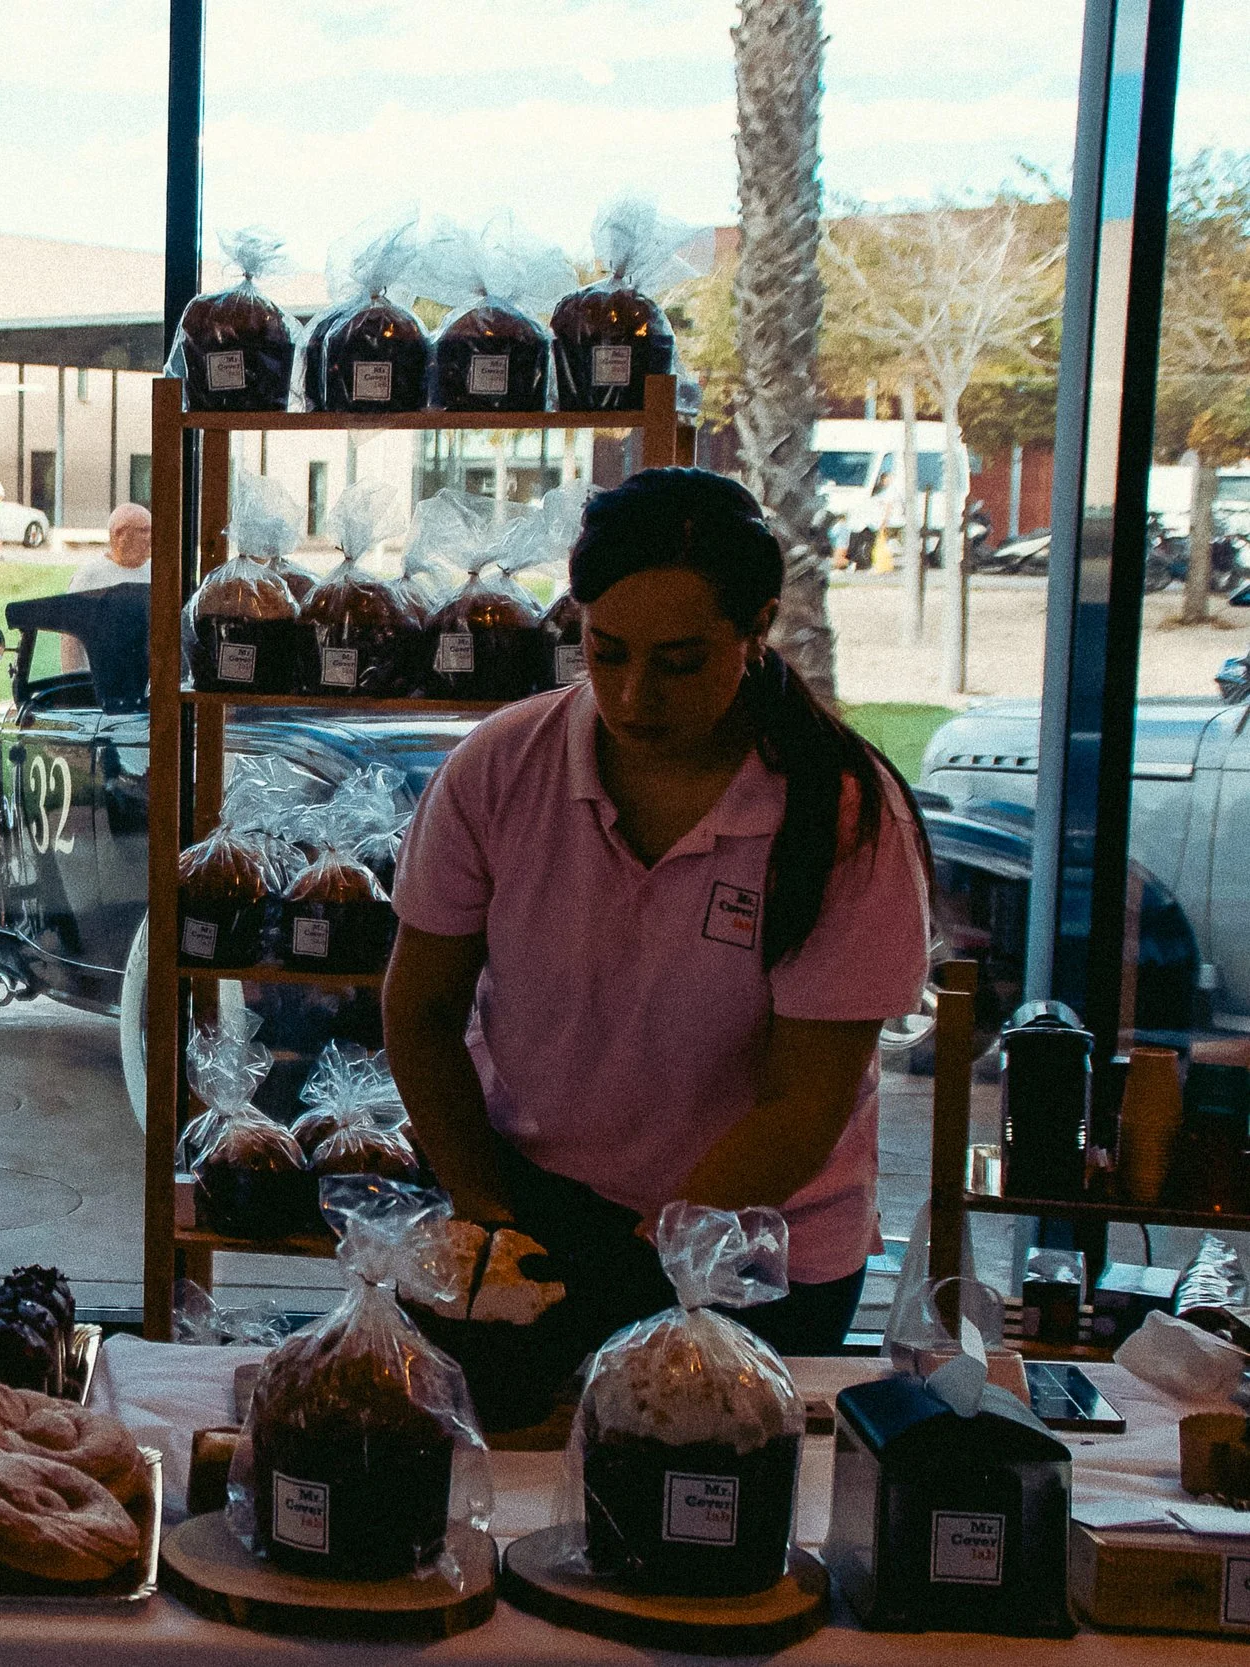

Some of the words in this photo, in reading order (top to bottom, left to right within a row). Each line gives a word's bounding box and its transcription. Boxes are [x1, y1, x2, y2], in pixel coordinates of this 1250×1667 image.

[29, 755, 75, 855] 32
[705, 1484, 728, 1496] Mr.
[286, 1499, 322, 1516] Cover
[685, 1495, 730, 1510] Cover
[706, 1510, 730, 1523] lab
[971, 1522, 996, 1534] Mr.
[951, 1533, 997, 1547] Cover
[971, 1548, 995, 1560] lab
